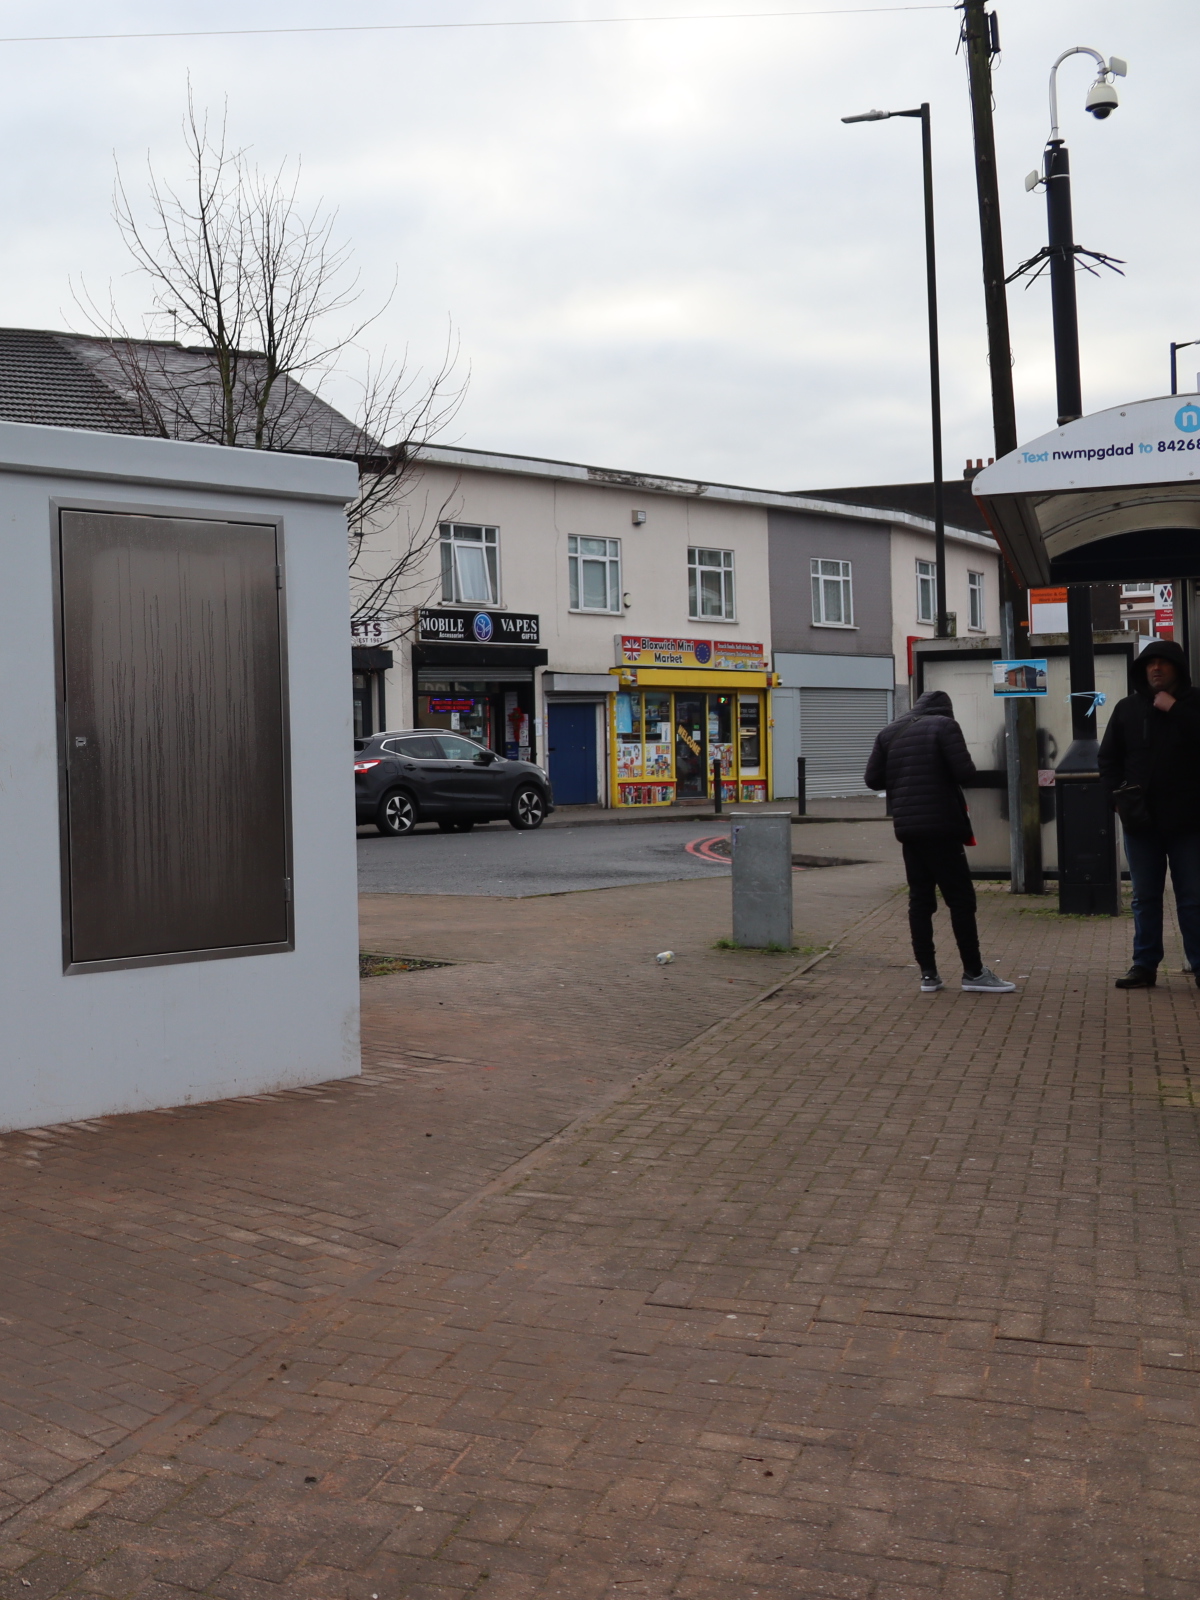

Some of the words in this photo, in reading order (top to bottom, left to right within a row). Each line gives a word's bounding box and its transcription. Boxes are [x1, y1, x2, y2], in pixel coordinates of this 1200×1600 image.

[1022, 451, 1049, 463] Text
[1052, 443, 1134, 461] nwmpgdad
[1138, 442, 1153, 454] to
[420, 617, 465, 632] MOBILE
[500, 618, 538, 633] VAPES
[642, 639, 676, 651] Bloxwich
[677, 640, 694, 652] Mini
[654, 652, 683, 664] Market
[677, 724, 702, 757] WELCOME
